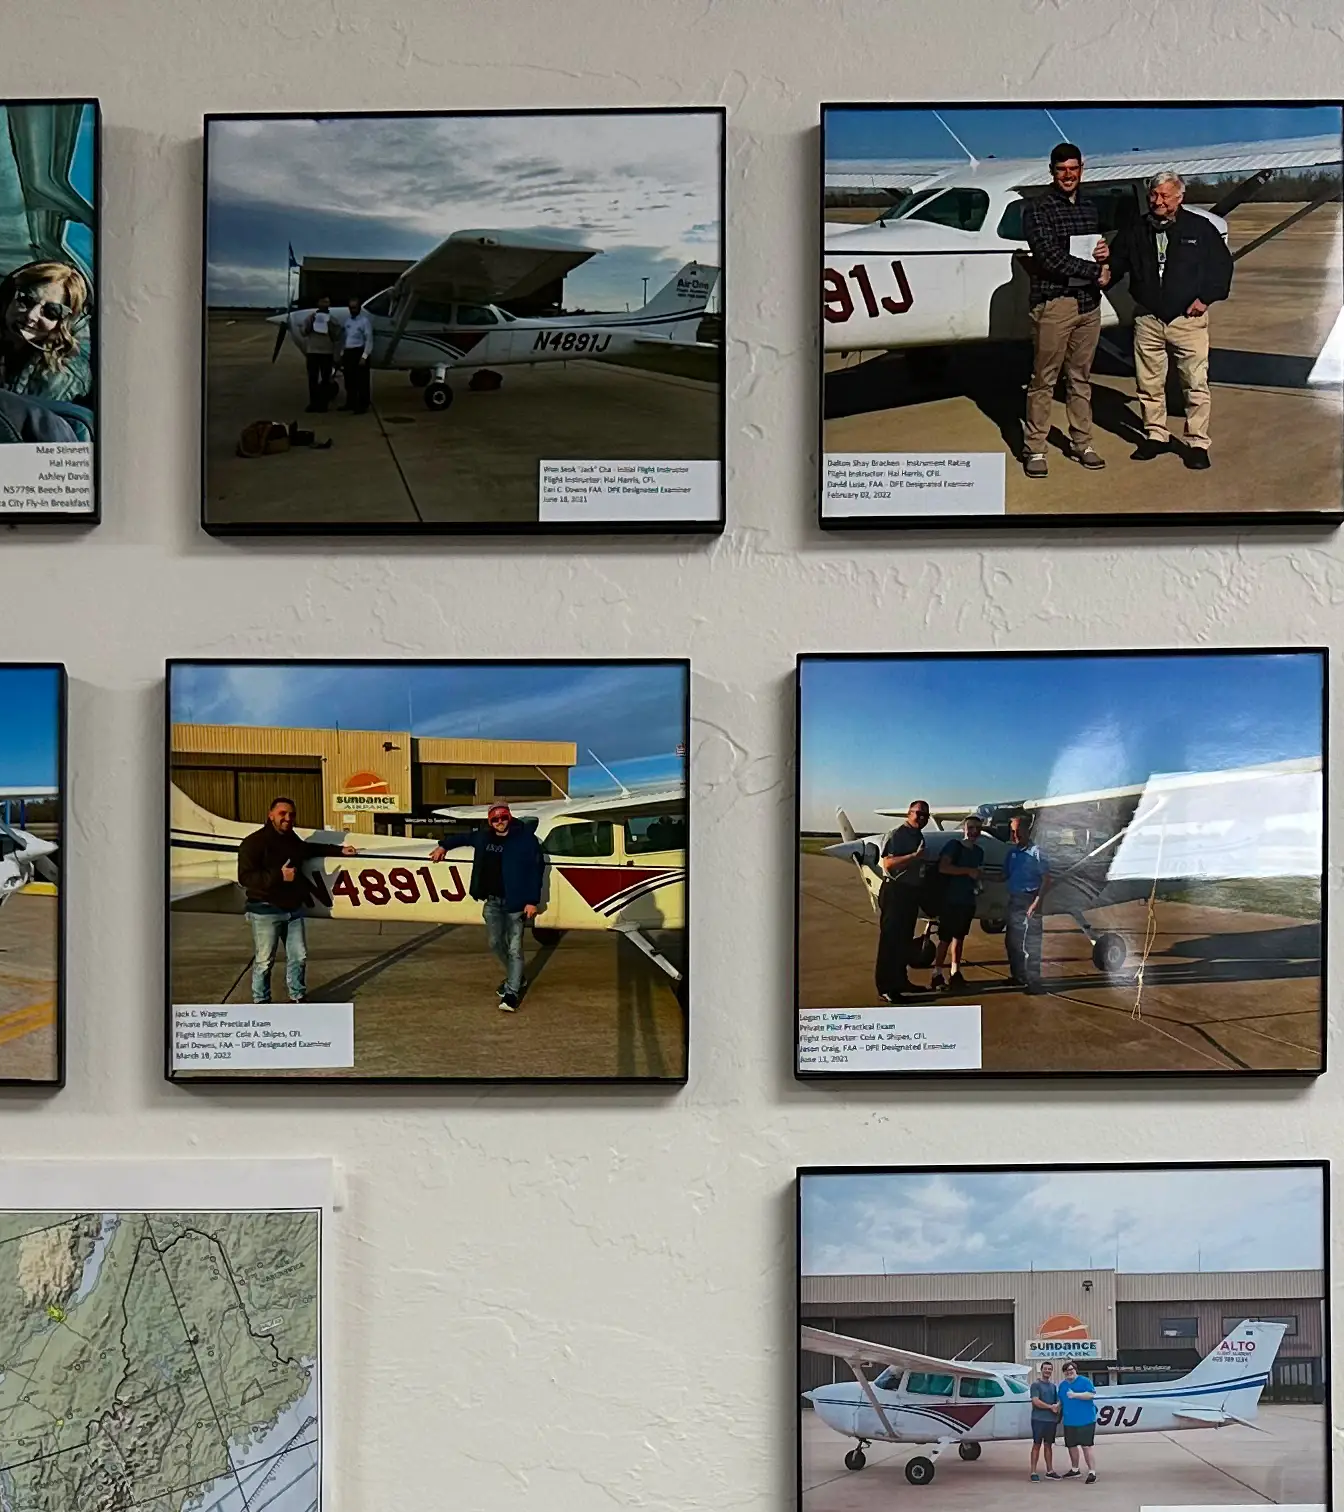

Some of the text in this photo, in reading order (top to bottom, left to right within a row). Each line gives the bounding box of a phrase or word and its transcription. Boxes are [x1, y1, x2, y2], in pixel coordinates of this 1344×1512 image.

[533, 330, 612, 353] N4891J
[38, 473, 65, 481] Ashley
[1220, 1341, 1256, 1351] ALTO
